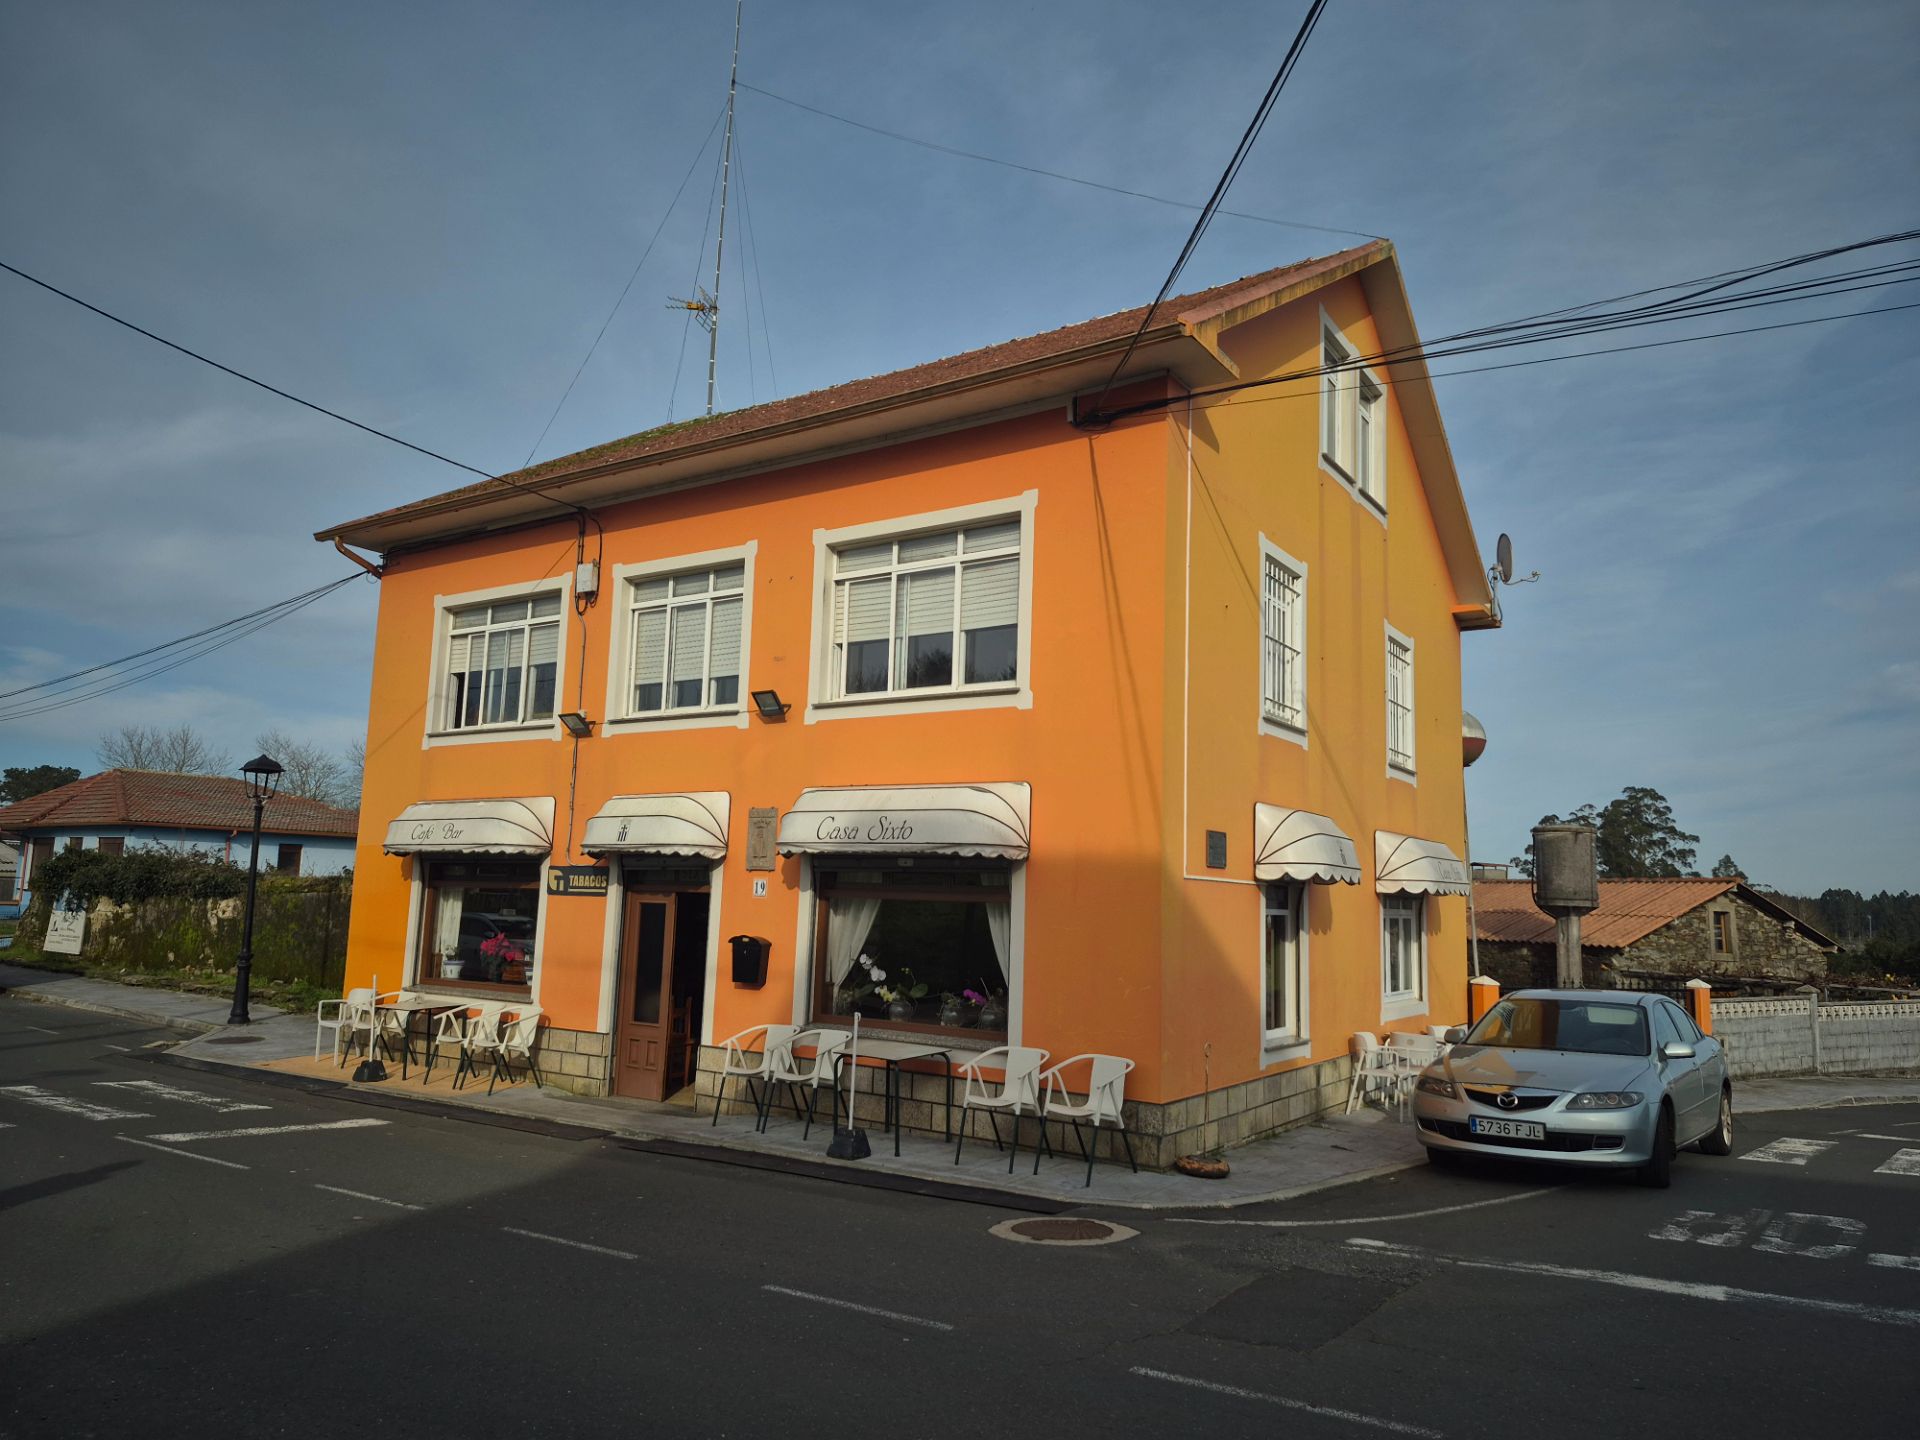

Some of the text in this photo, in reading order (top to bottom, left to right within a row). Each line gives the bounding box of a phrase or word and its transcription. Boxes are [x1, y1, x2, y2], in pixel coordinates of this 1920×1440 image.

[411, 822, 464, 844] Café Bar
[816, 815, 913, 841] Casa Sixto
[568, 875, 607, 887] TABACOS
[755, 881, 765, 895] 19
[1478, 1120, 1541, 1138] 5736 FJL
